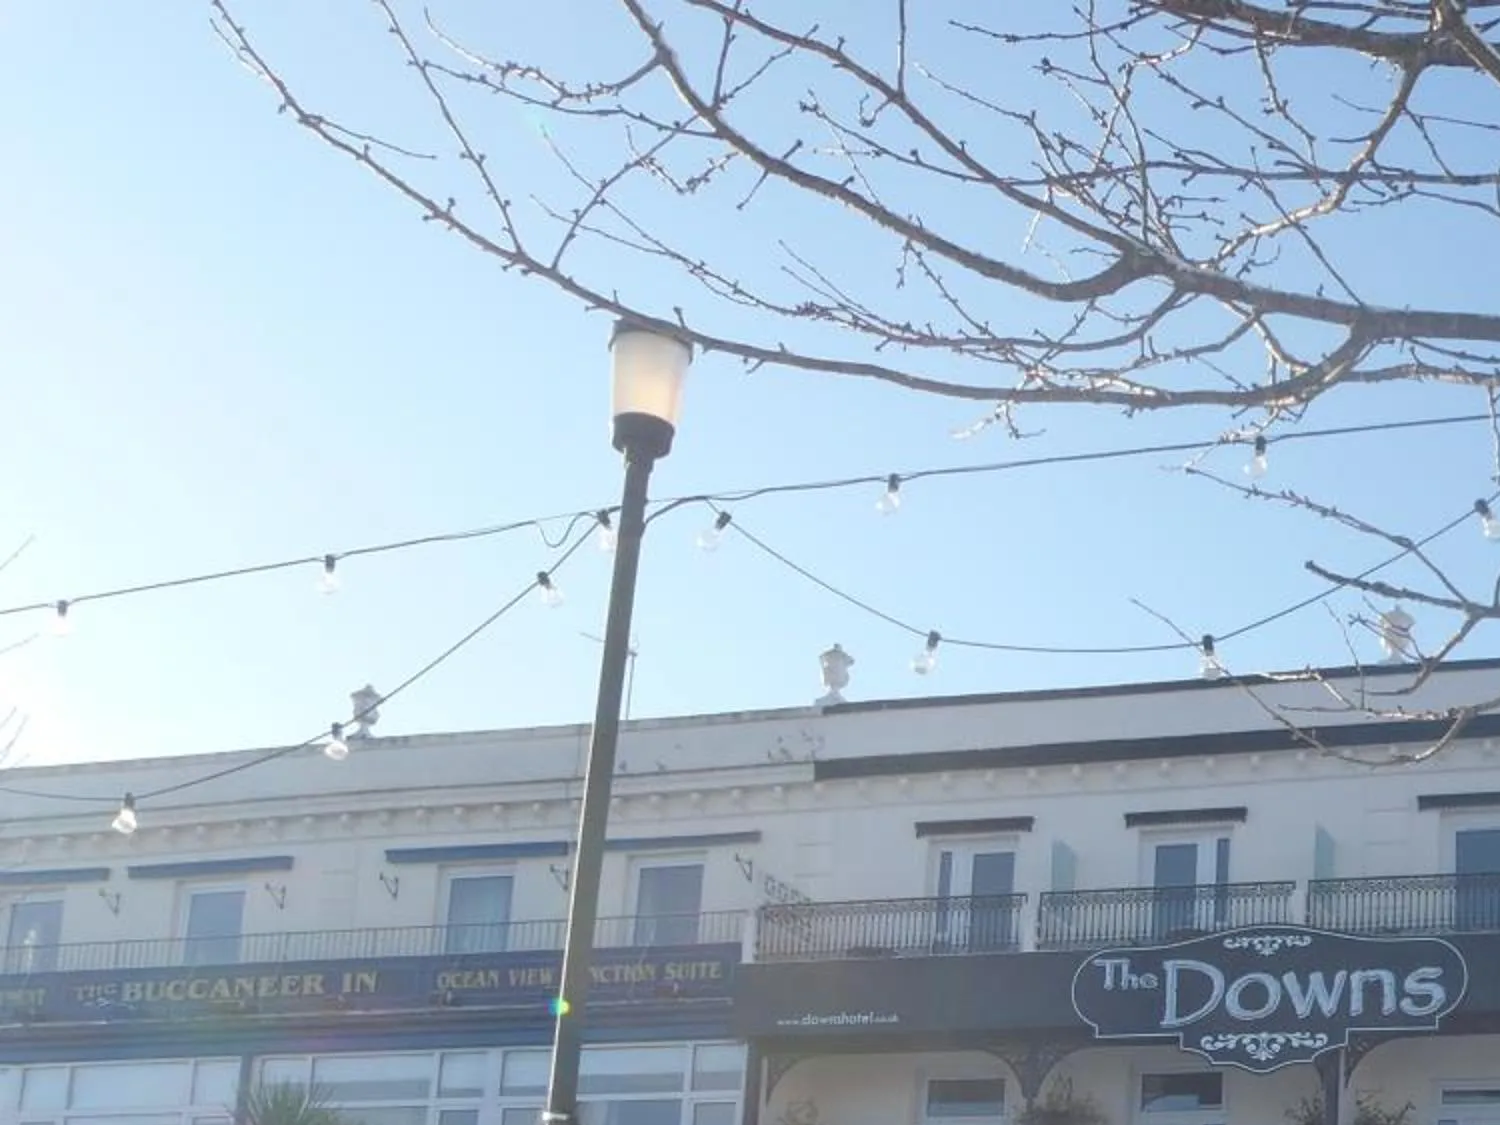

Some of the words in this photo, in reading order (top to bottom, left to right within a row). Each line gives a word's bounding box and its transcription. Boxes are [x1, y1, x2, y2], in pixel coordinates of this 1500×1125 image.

[121, 973, 324, 1001] BUCCANEER
[437, 968, 499, 989] OCEAN
[508, 966, 552, 987] VIEW
[664, 960, 722, 981] SUITE
[1094, 957, 1159, 991] The
[1160, 958, 1446, 1028] Downs
